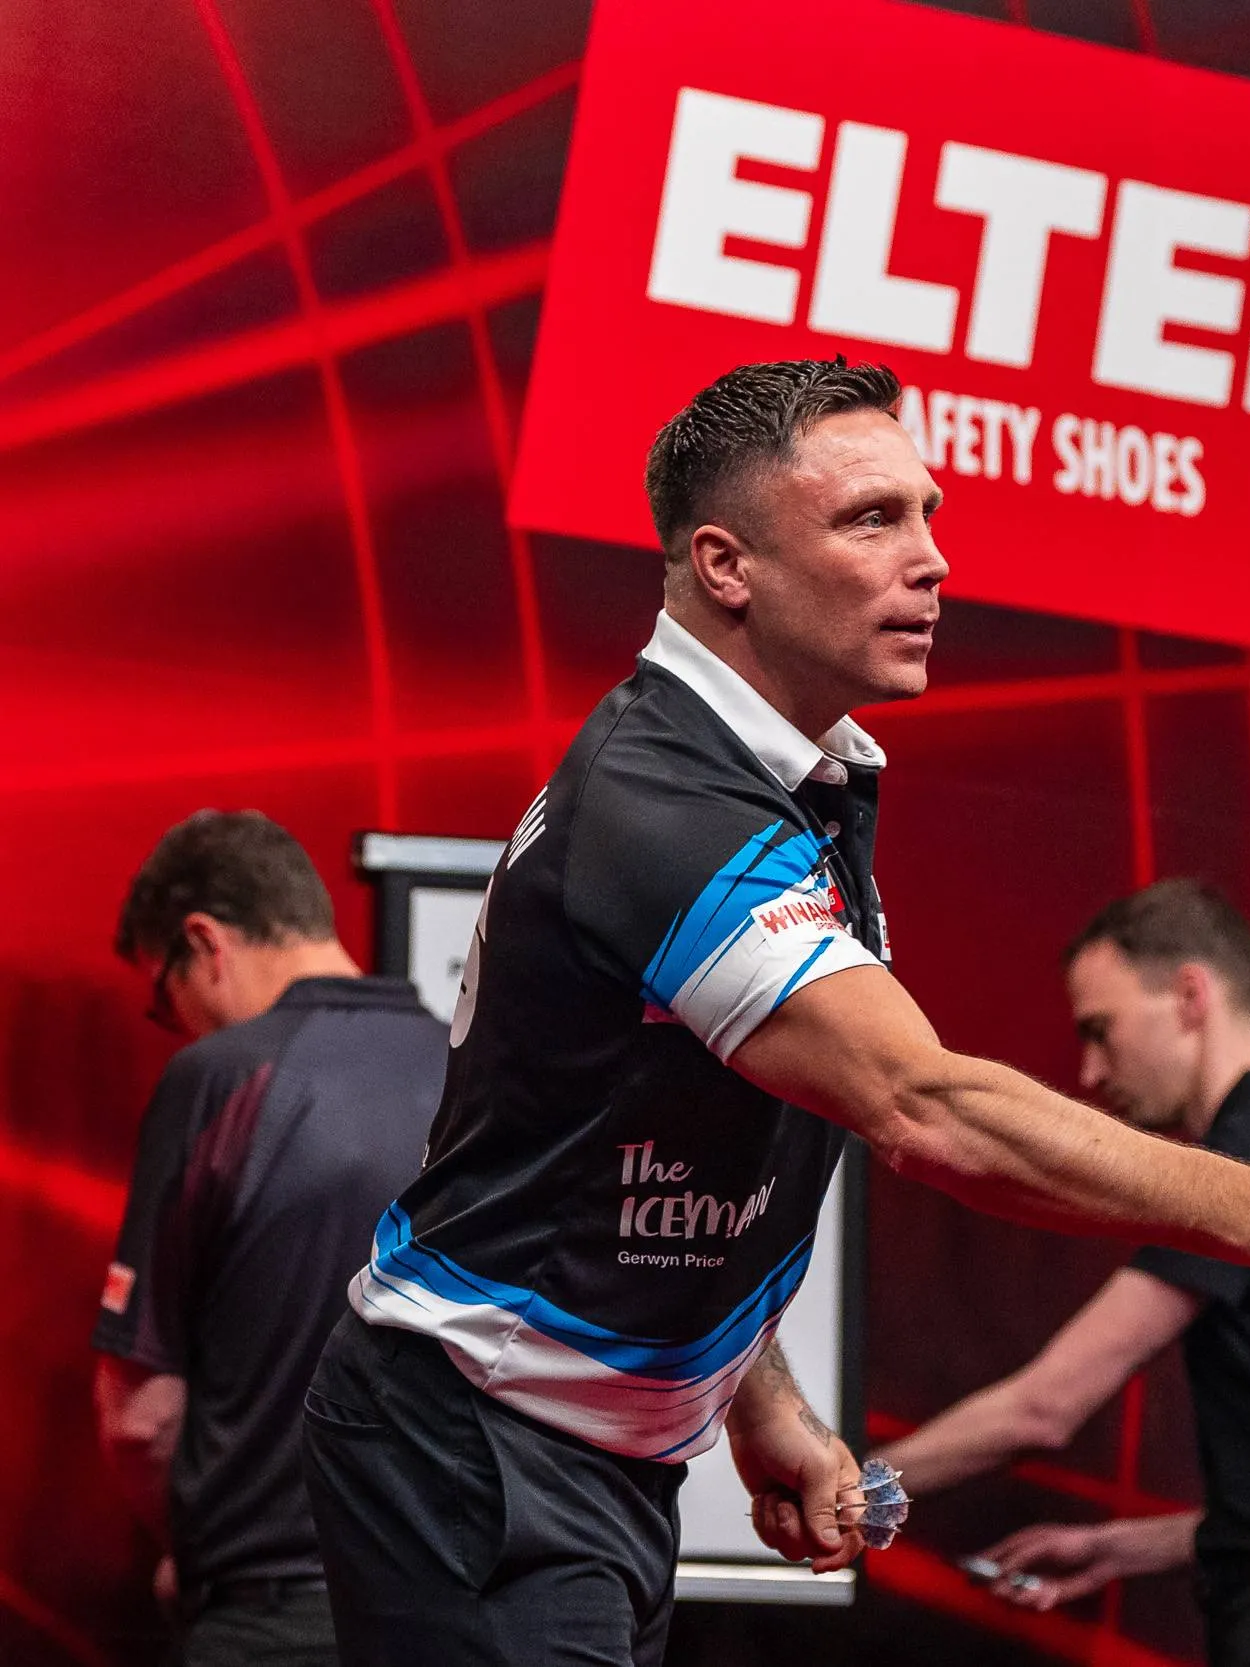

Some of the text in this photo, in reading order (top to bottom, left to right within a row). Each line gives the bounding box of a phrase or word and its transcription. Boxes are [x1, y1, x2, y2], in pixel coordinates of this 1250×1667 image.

[899, 385, 1206, 517] AFETY SHOES
[616, 1139, 694, 1185] The
[617, 1251, 725, 1269] Gerwyn Price
